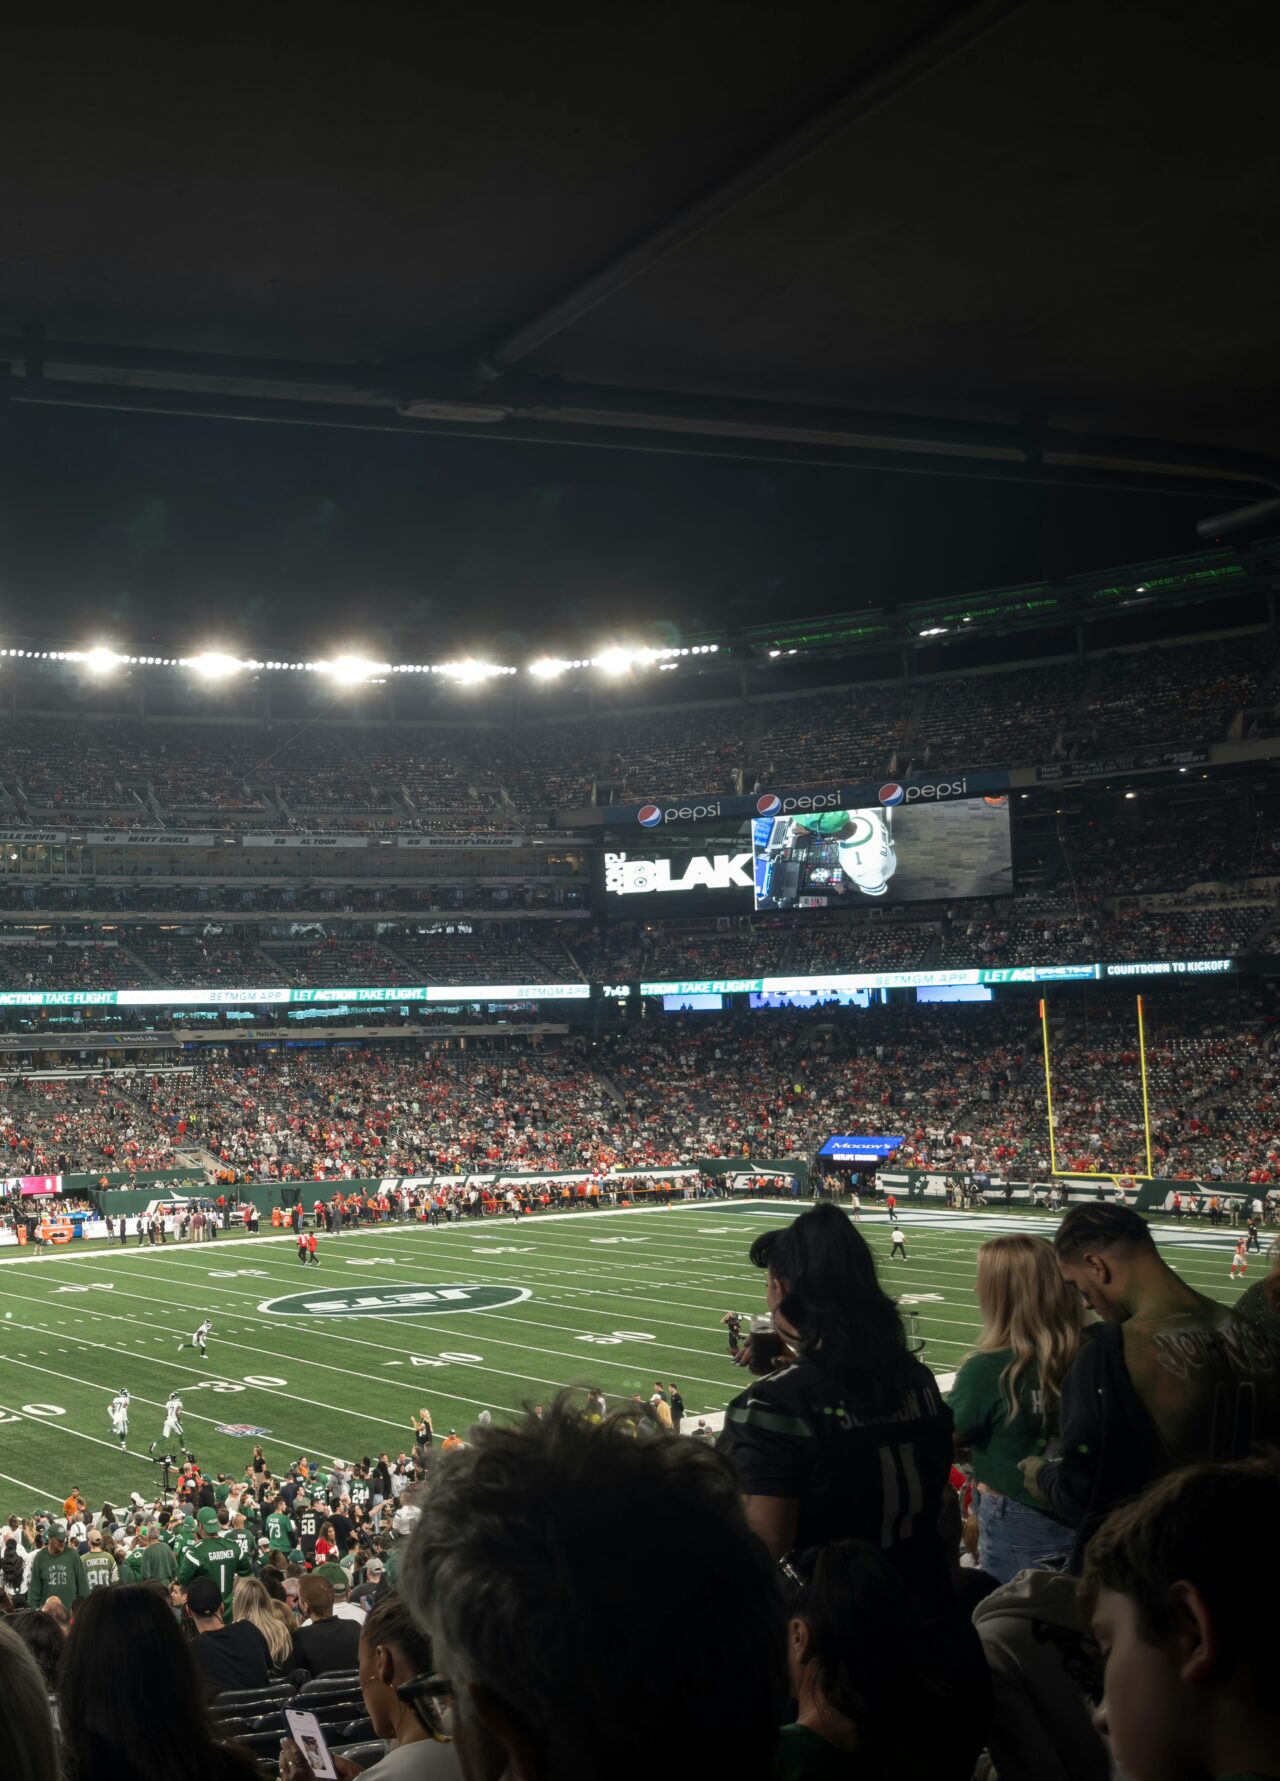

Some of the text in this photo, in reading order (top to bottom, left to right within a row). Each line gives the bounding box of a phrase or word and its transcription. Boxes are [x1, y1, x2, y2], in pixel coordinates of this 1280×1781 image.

[906, 778, 966, 802] pepsi
[783, 790, 840, 813] pepsi
[665, 802, 720, 823] pepsi
[624, 853, 754, 893] BLAK
[1107, 960, 1230, 975] COUNTDOWN TO KICKOFF
[984, 971, 1007, 982] LET
[293, 990, 312, 1001] LET
[357, 990, 383, 1001] TAKE
[679, 982, 711, 994] TAKE
[44, 993, 72, 1004] TAKE
[574, 1331, 656, 1344] 50
[410, 1352, 483, 1366] 40
[198, 1376, 287, 1392] 30
[352, 1488, 364, 1504] 24
[879, 1442, 923, 1548] 11
[268, 1522, 281, 1539] 73
[301, 1519, 316, 1535] 58
[208, 1549, 234, 1561] GARDNER
[236, 1539, 248, 1556] 74
[47, 1571, 67, 1586] JETS
[220, 1564, 225, 1593] 1
